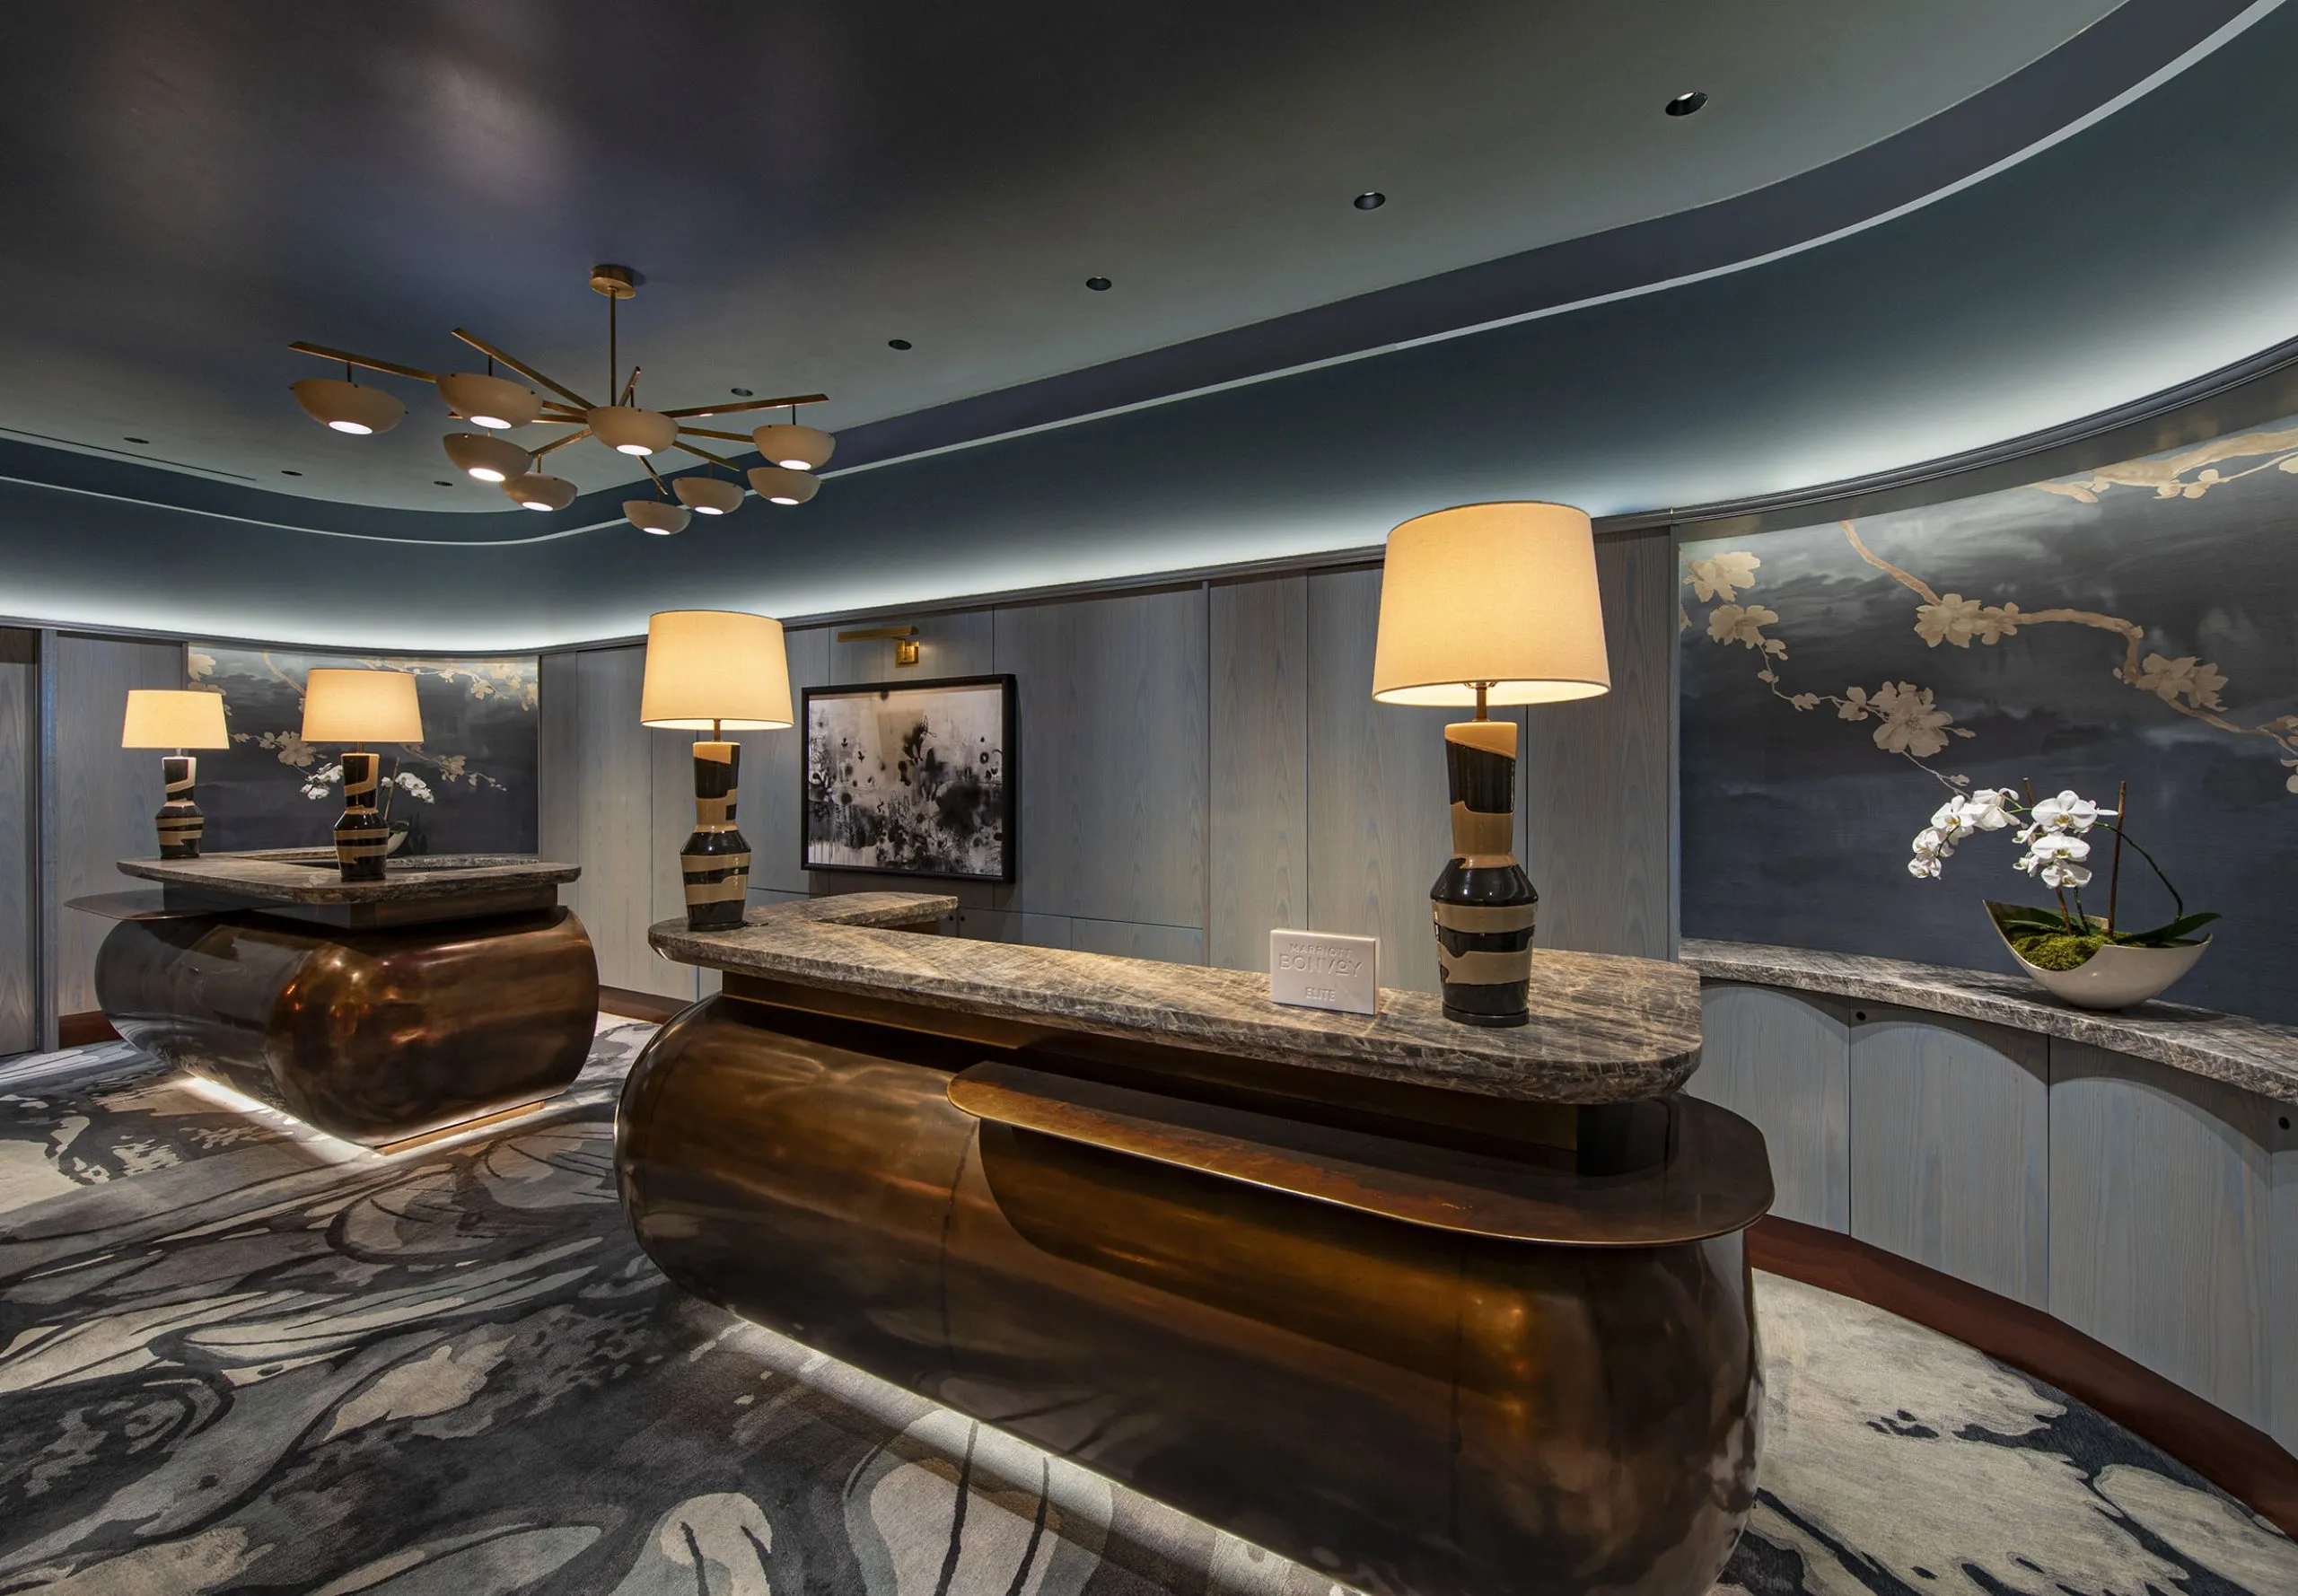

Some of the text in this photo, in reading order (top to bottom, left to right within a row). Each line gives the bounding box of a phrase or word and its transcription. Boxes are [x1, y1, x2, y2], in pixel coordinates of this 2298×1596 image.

[1290, 943, 1353, 958] MARRIOTT
[1279, 953, 1364, 978] BONVOY
[1305, 987, 1336, 1002] ELITE
